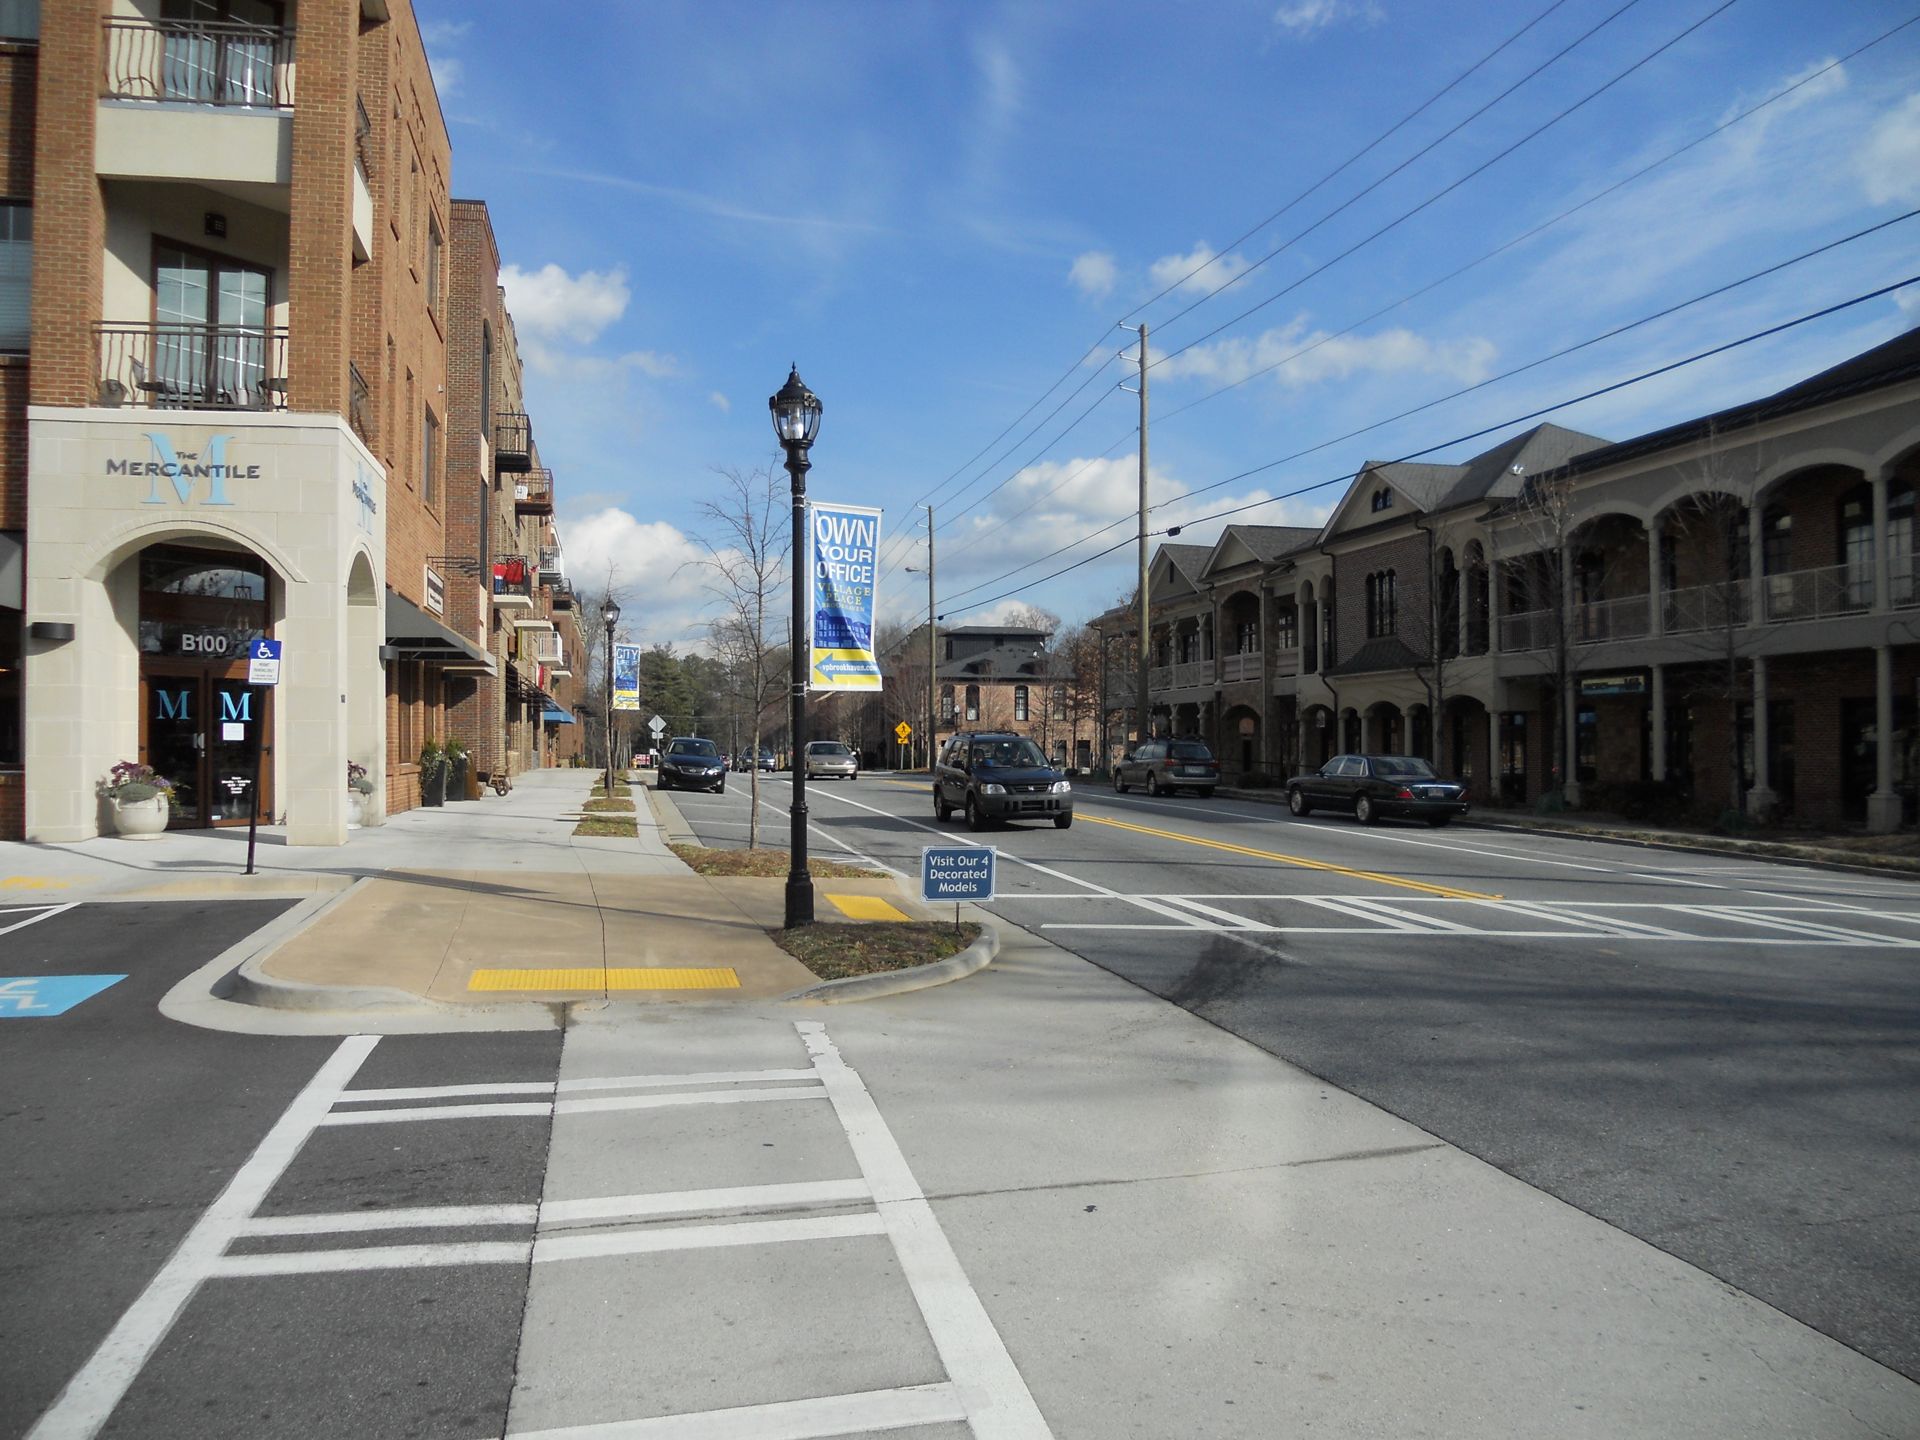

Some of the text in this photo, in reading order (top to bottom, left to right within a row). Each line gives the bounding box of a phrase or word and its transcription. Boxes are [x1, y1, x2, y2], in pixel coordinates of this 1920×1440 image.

[176, 451, 198, 460] THE
[106, 458, 260, 479] MERCANTILE
[816, 515, 875, 548] OWN
[818, 543, 873, 563] YOUR
[816, 561, 872, 584] OFFICE
[818, 583, 872, 597] VILLAGE
[826, 592, 862, 605] PLACE
[182, 634, 228, 653] B100
[616, 648, 638, 660] CITY
[156, 690, 191, 719] M
[220, 692, 252, 720] M
[929, 856, 989, 866] Visit Our 4
[930, 868, 988, 880] Decorated
[938, 882, 978, 893] Models
